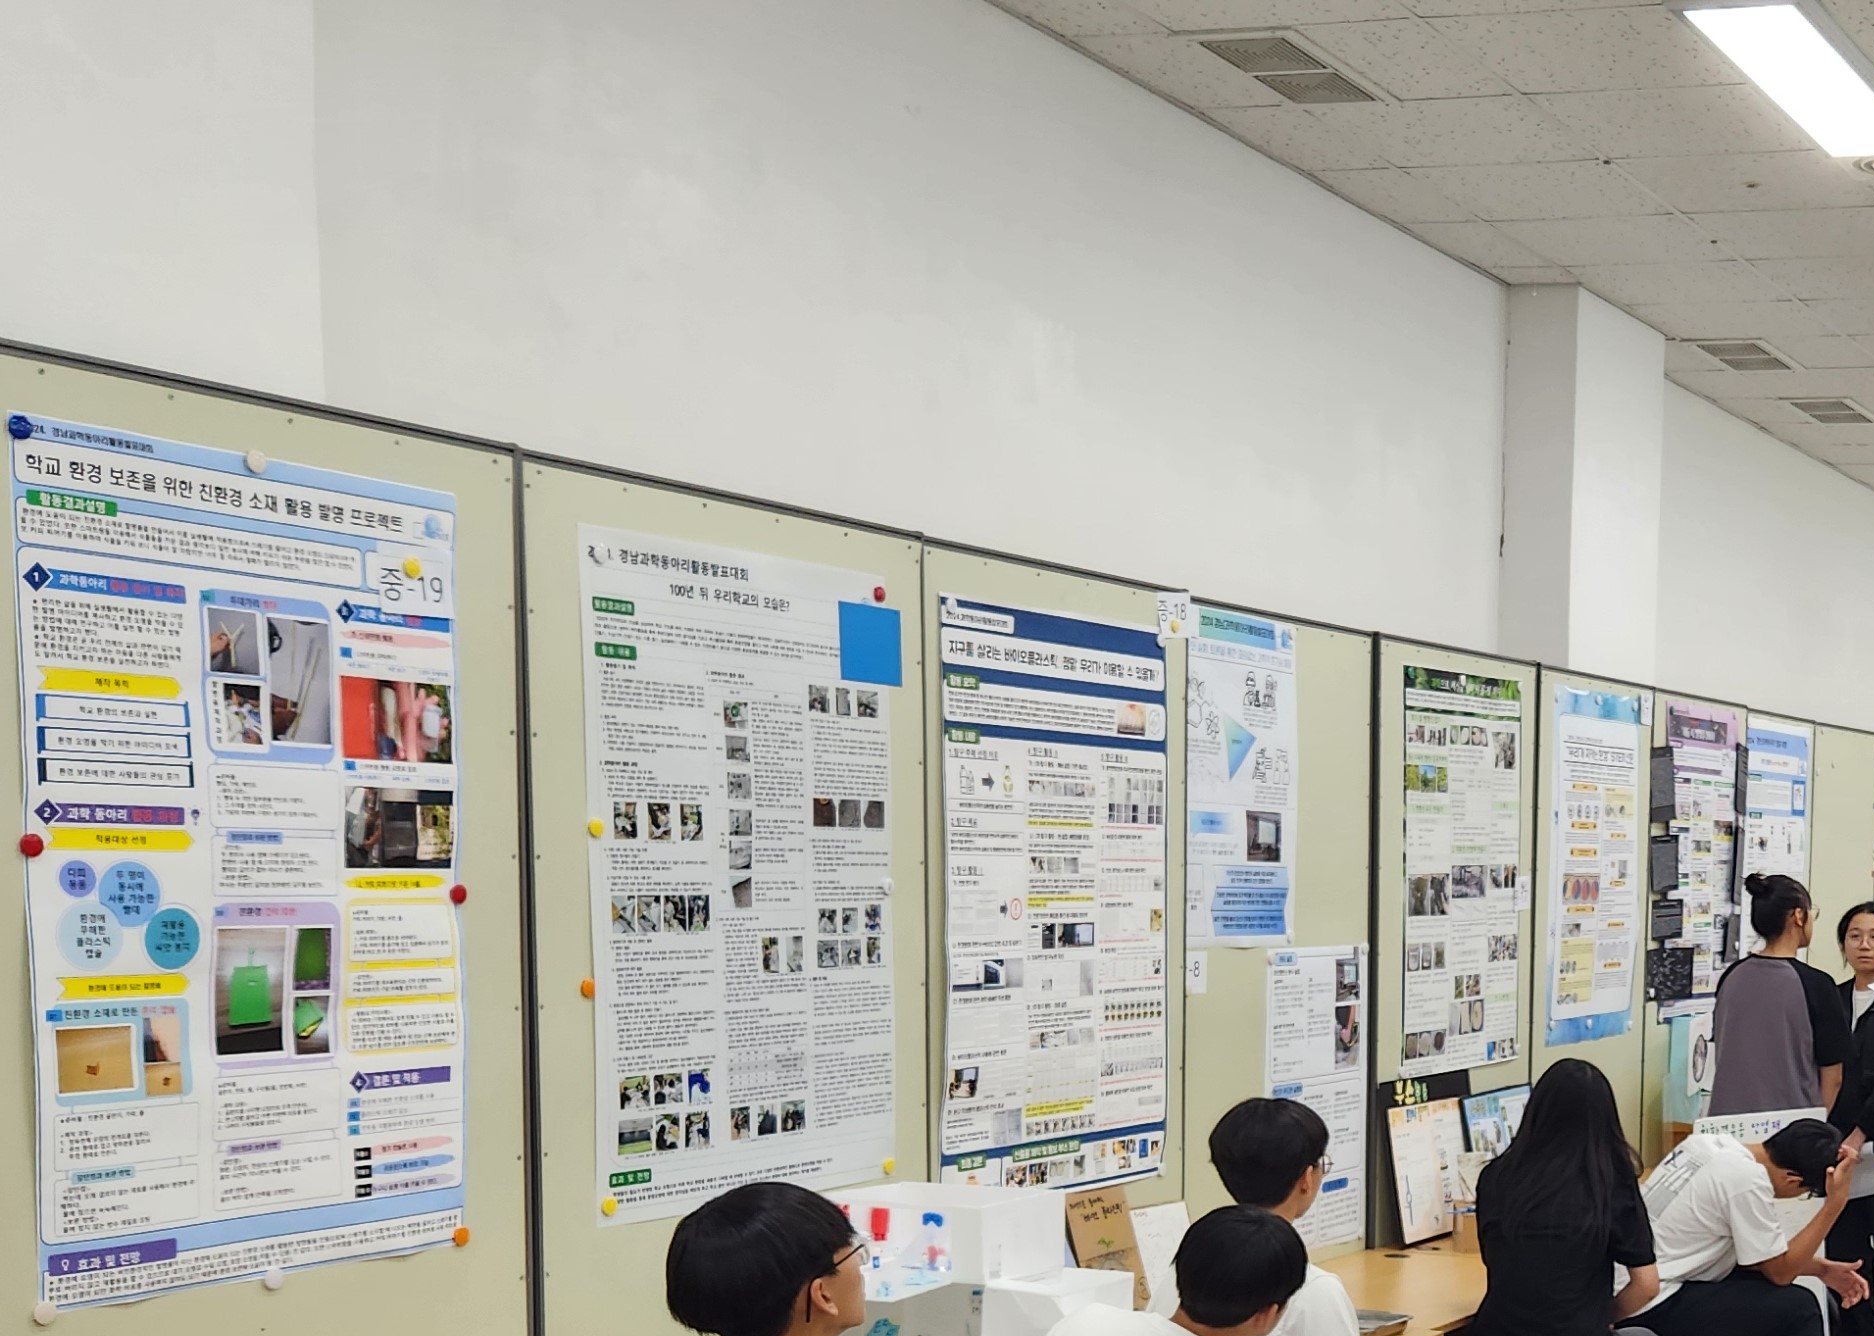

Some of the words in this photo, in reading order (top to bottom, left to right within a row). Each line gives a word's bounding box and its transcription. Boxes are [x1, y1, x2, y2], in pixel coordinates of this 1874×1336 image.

[26, 453, 62, 476] 학교
[69, 461, 102, 484] 환경
[109, 466, 157, 493] 보존을
[163, 476, 193, 499] 위한
[199, 483, 243, 508] 친환경
[249, 492, 278, 514] 소재
[284, 497, 312, 520] 활용
[318, 503, 344, 525] 발명
[350, 507, 403, 534] 프로젝트
[619, 548, 749, 581] 경남과학동아리활동발표대회
[32, 571, 40, 583] 1
[59, 573, 108, 590] 과학동아리
[381, 566, 444, 603] 중-19
[670, 583, 694, 600] 100년
[699, 587, 709, 601] 뒤
[713, 588, 759, 608] 우리학교의
[763, 596, 790, 612] 모습은?
[948, 639, 975, 659] 지구를
[977, 643, 1002, 662] 살리는
[1080, 658, 1102, 676] 우리가
[43, 807, 51, 818] 2
[66, 806, 91, 821] 과학
[94, 807, 128, 822] 동아리
[77, 1255, 102, 1272] 효과
[104, 1254, 117, 1268] 및
